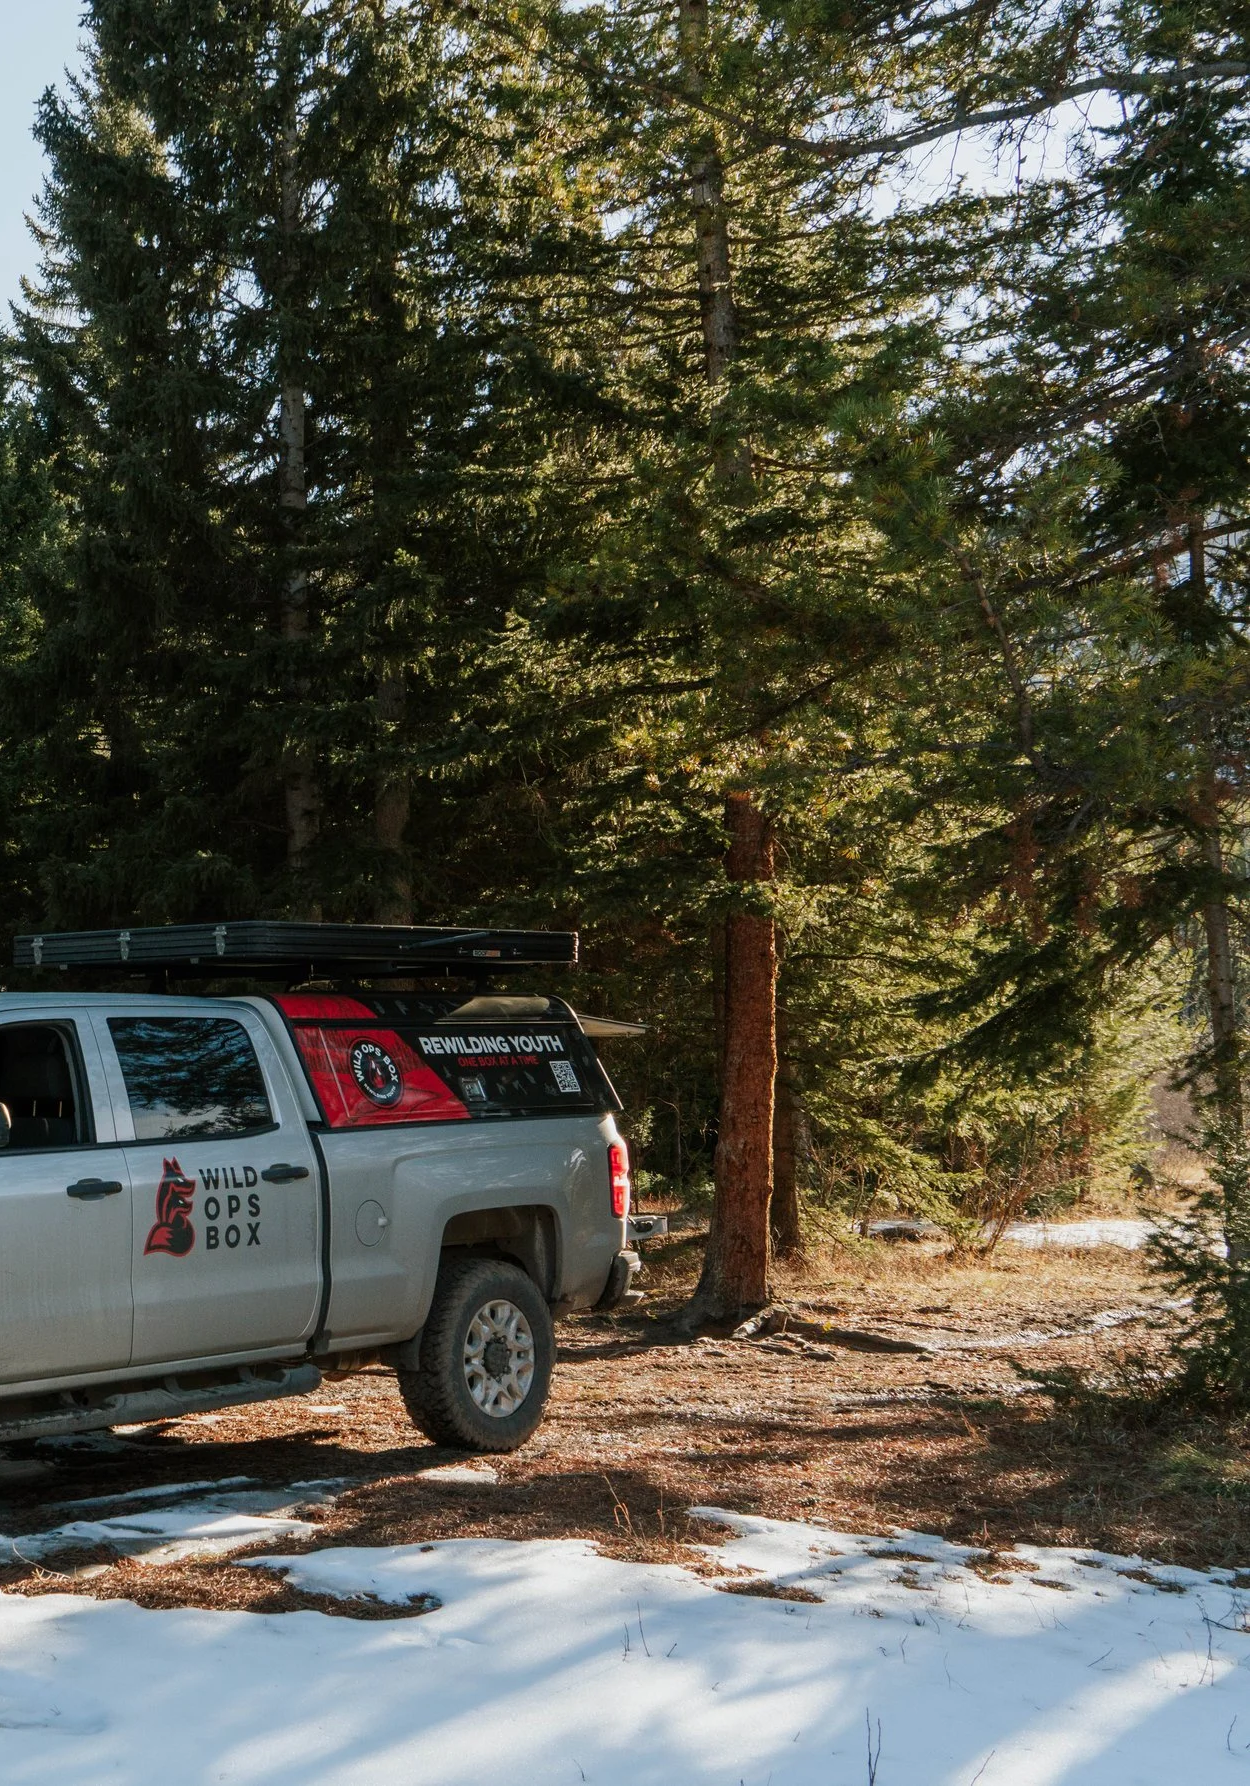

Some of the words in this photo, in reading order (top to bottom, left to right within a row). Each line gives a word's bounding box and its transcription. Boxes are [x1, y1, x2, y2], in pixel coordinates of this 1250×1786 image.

[419, 1036, 508, 1054] REWILDING
[507, 1035, 565, 1052] YOUTH
[353, 1049, 365, 1082] WILD
[361, 1044, 381, 1057] OPS
[383, 1055, 399, 1083] BOX
[458, 1056, 478, 1067] ONE
[478, 1056, 496, 1066] BOX
[499, 1056, 509, 1066] AT
[511, 1056, 518, 1065] A
[517, 1055, 539, 1065] TIME
[198, 1166, 258, 1190] WILD
[204, 1193, 261, 1221] OPS
[206, 1222, 261, 1250] BOX
